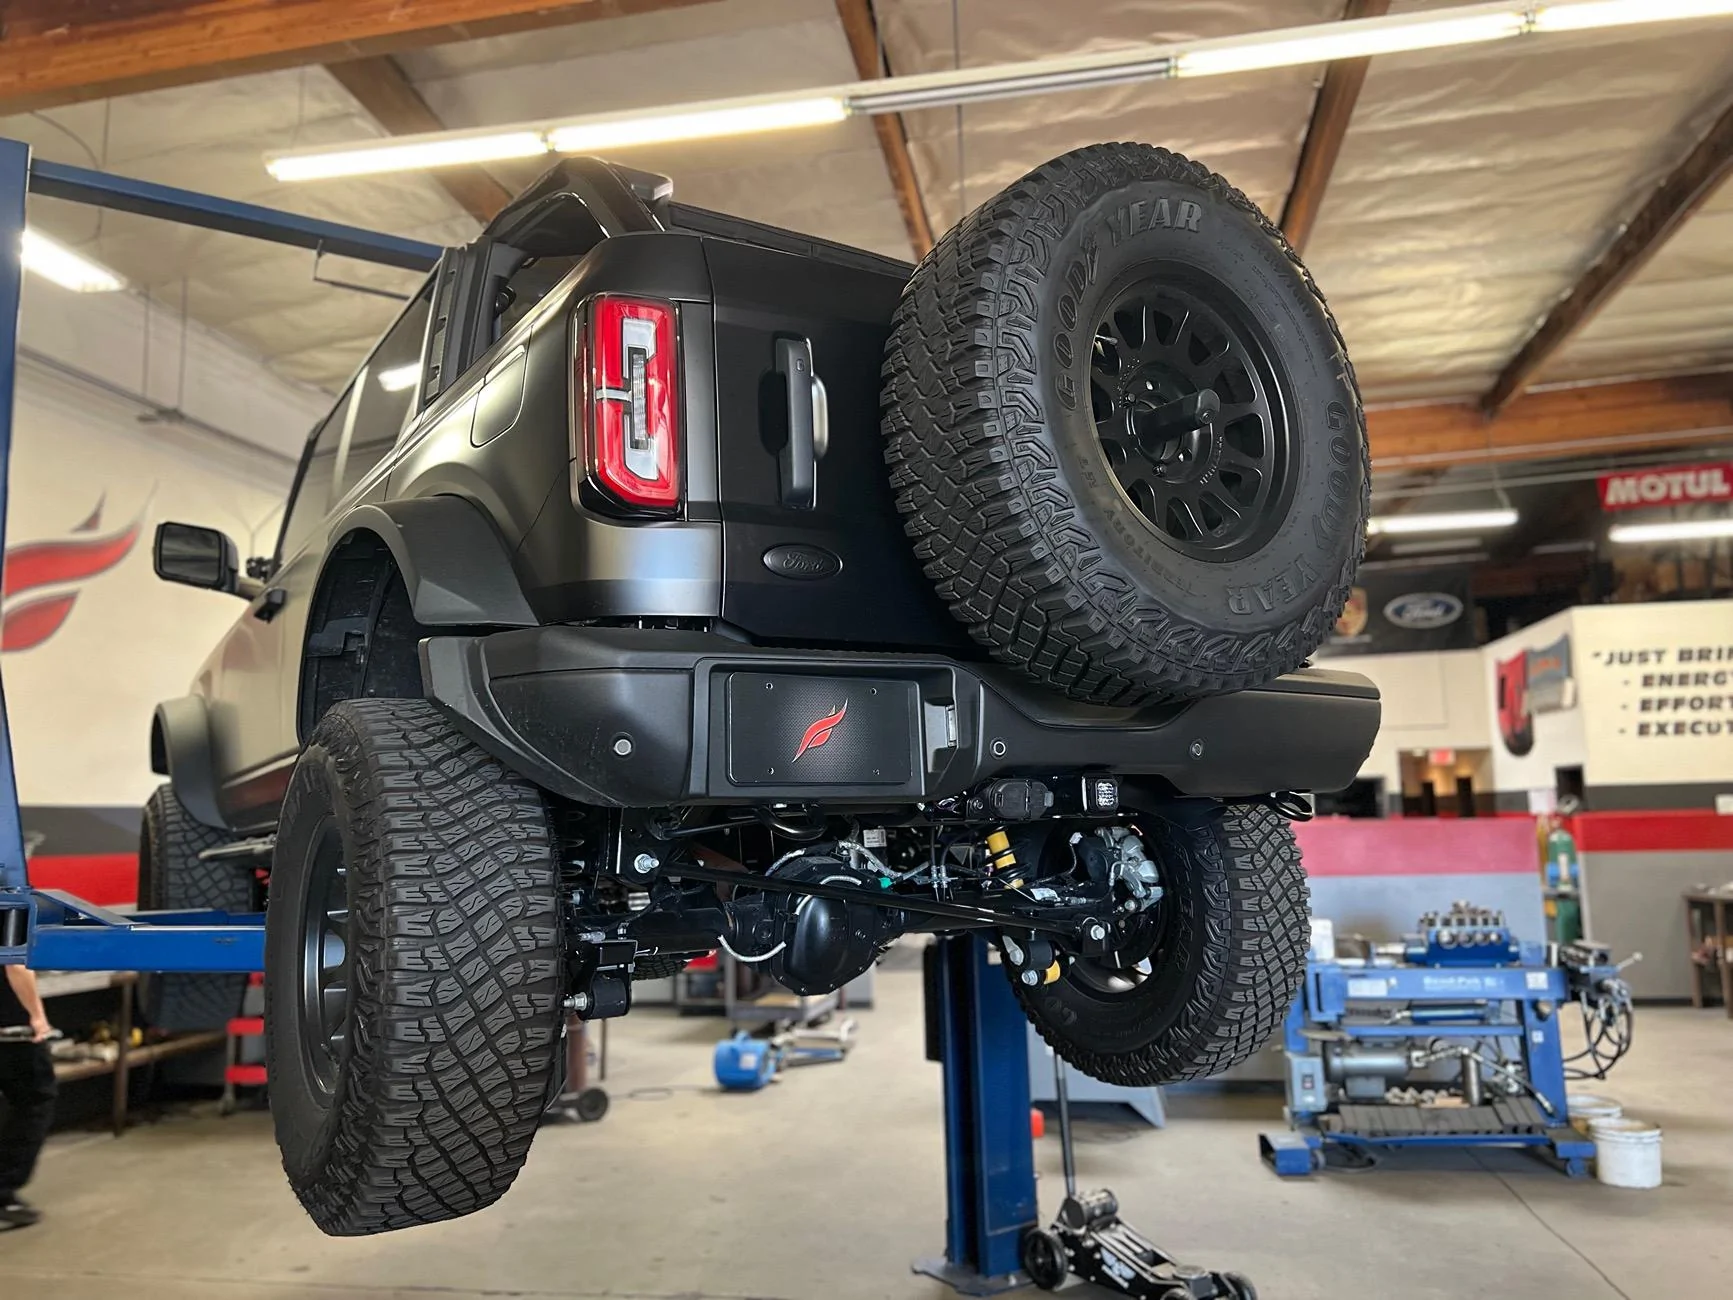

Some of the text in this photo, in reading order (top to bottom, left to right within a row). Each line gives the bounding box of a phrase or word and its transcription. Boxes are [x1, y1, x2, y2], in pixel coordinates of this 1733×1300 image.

[1605, 468, 1731, 505] MOTUL
[783, 551, 825, 572] Ford
[1641, 671, 1733, 688] ENERG
